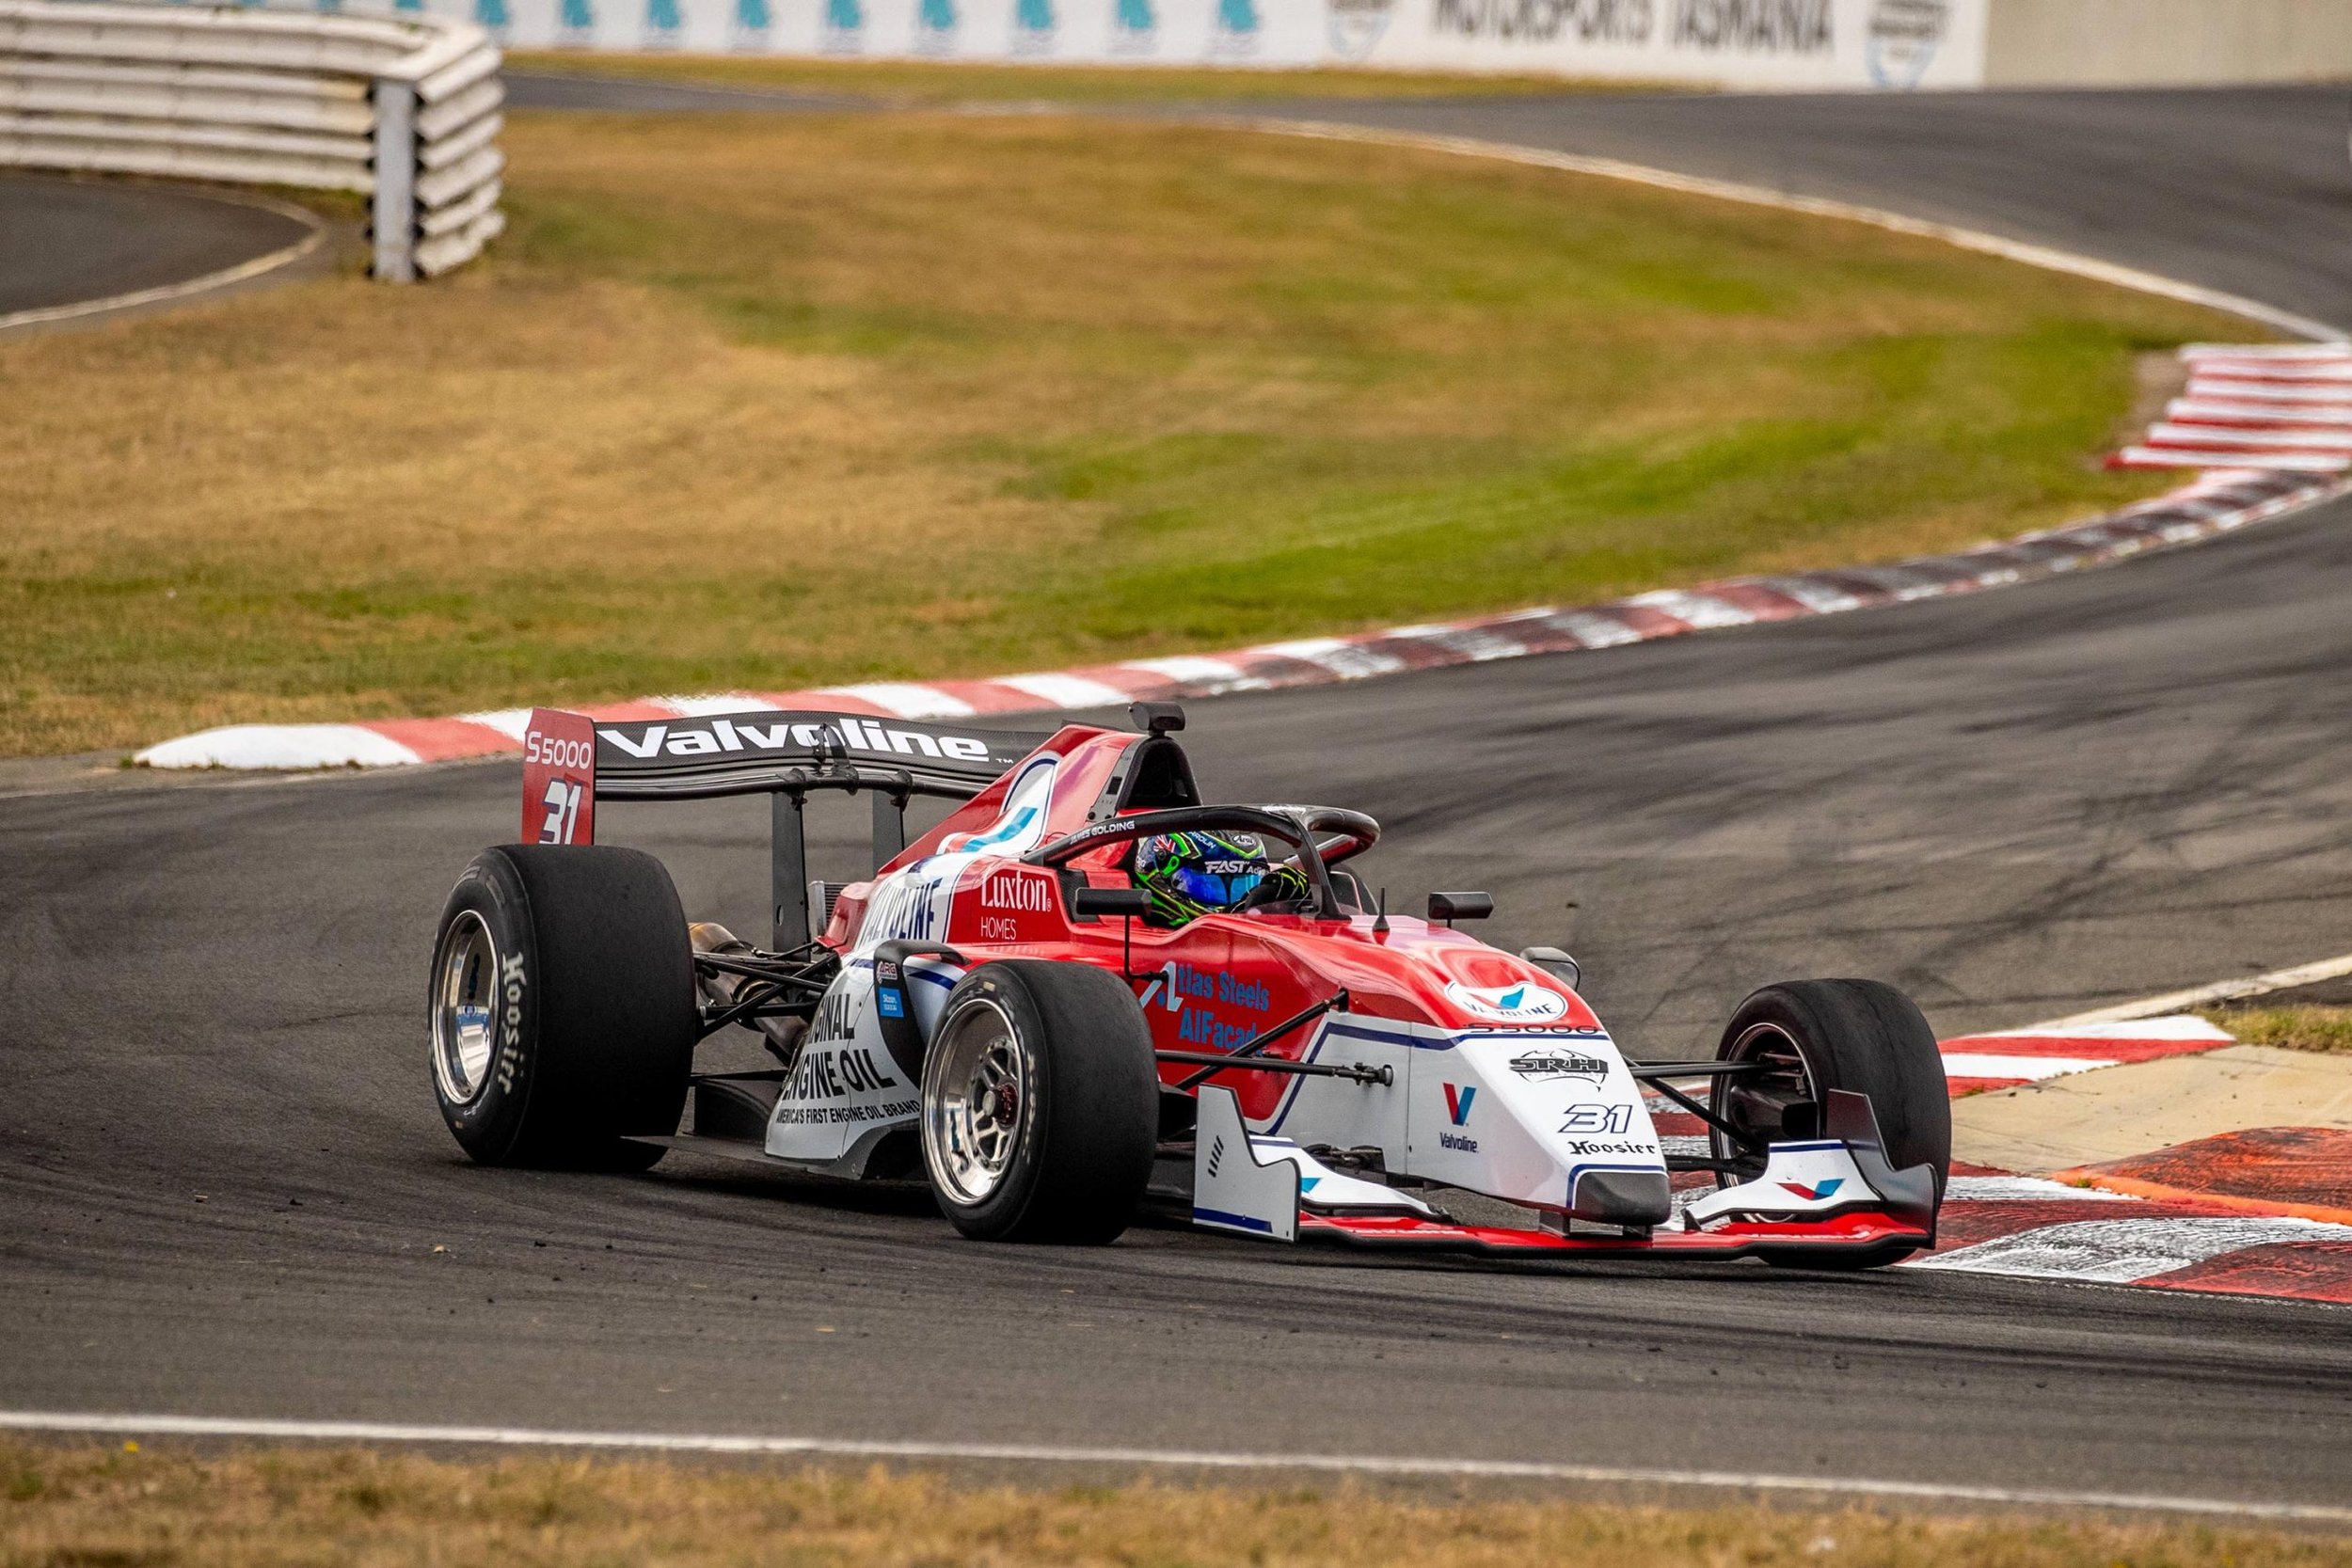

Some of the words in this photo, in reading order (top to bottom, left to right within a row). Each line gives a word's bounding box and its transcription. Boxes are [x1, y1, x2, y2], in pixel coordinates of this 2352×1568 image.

[526, 731, 592, 770] S5000
[596, 718, 990, 763] Valvoline
[539, 777, 582, 845] 31
[1091, 820, 1136, 836] GOLDING
[981, 870, 1047, 911] Luxton
[980, 915, 1017, 940] HOMES
[1218, 971, 1270, 1012] Steels
[1462, 1022, 1599, 1035] S5000
[839, 1048, 898, 1092] OIL
[775, 1107, 805, 1125] AMERICA'S
[805, 1108, 829, 1124] FIRST
[830, 1106, 867, 1123] ENGINE
[865, 1103, 883, 1120] OIL
[882, 1099, 921, 1117] BRAND
[1557, 1103, 1633, 1134] 31
[1439, 1132, 1478, 1153] Valvoline
[1567, 1140, 1656, 1155] Hoosier
